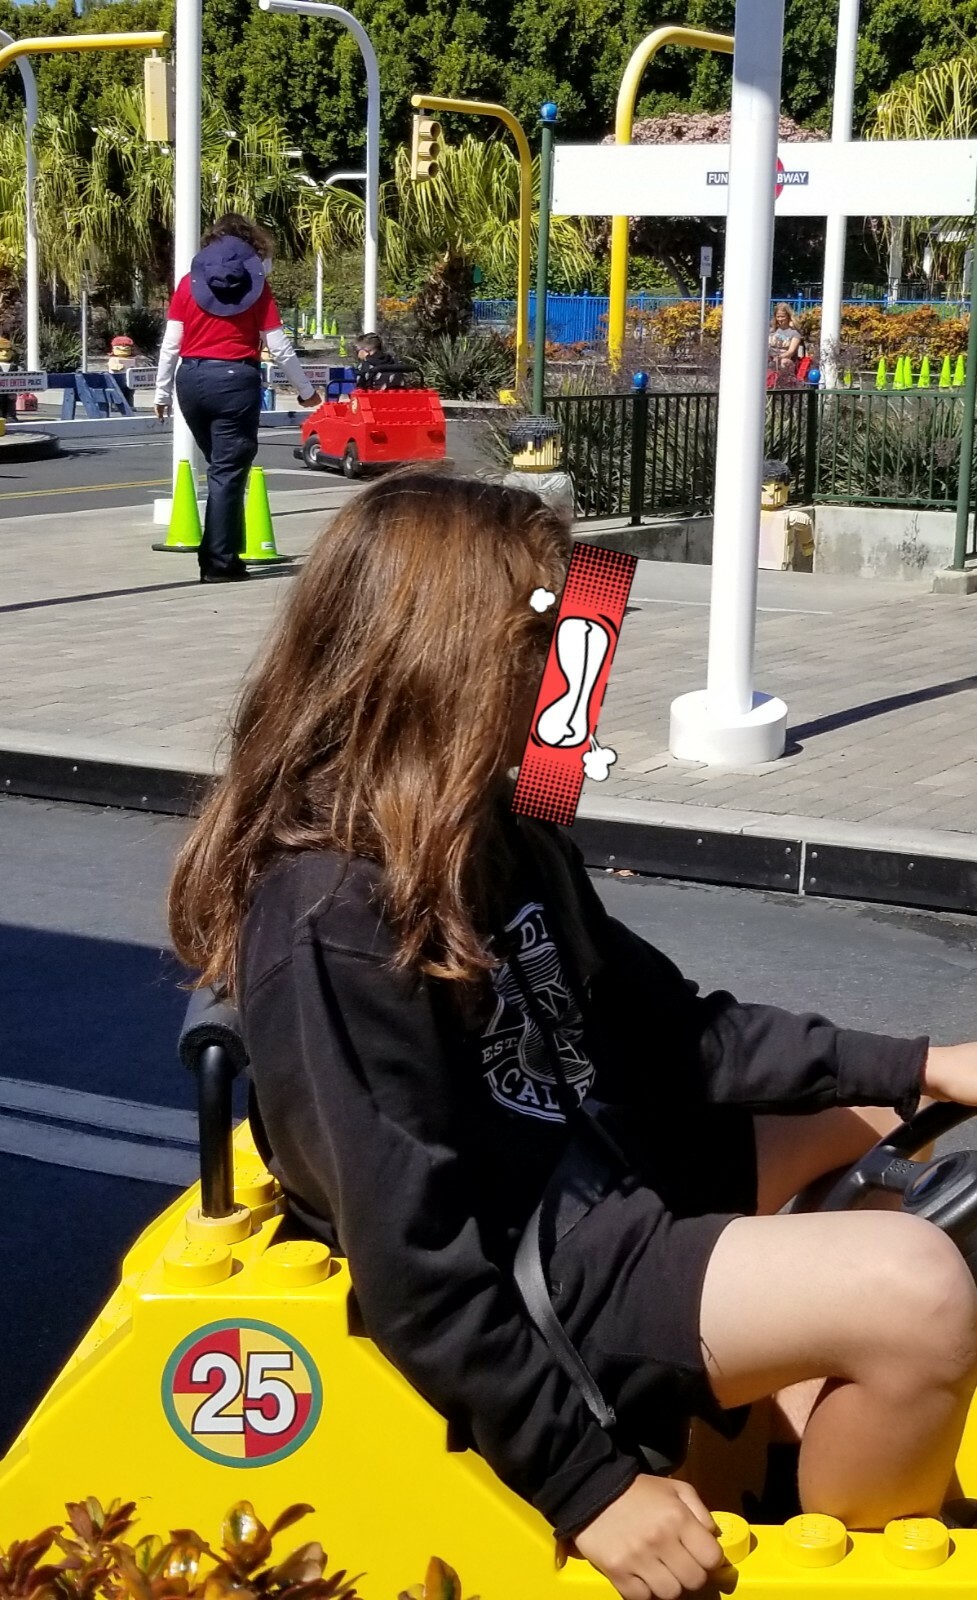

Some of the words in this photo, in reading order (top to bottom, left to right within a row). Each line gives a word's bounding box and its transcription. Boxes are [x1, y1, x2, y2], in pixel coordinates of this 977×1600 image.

[776, 172, 807, 184] BWAY
[27, 378, 42, 386] POLICE
[520, 914, 549, 951] DI
[481, 1037, 518, 1064] EST.
[501, 1068, 590, 1109] CALF
[190, 1350, 298, 1437] 25
